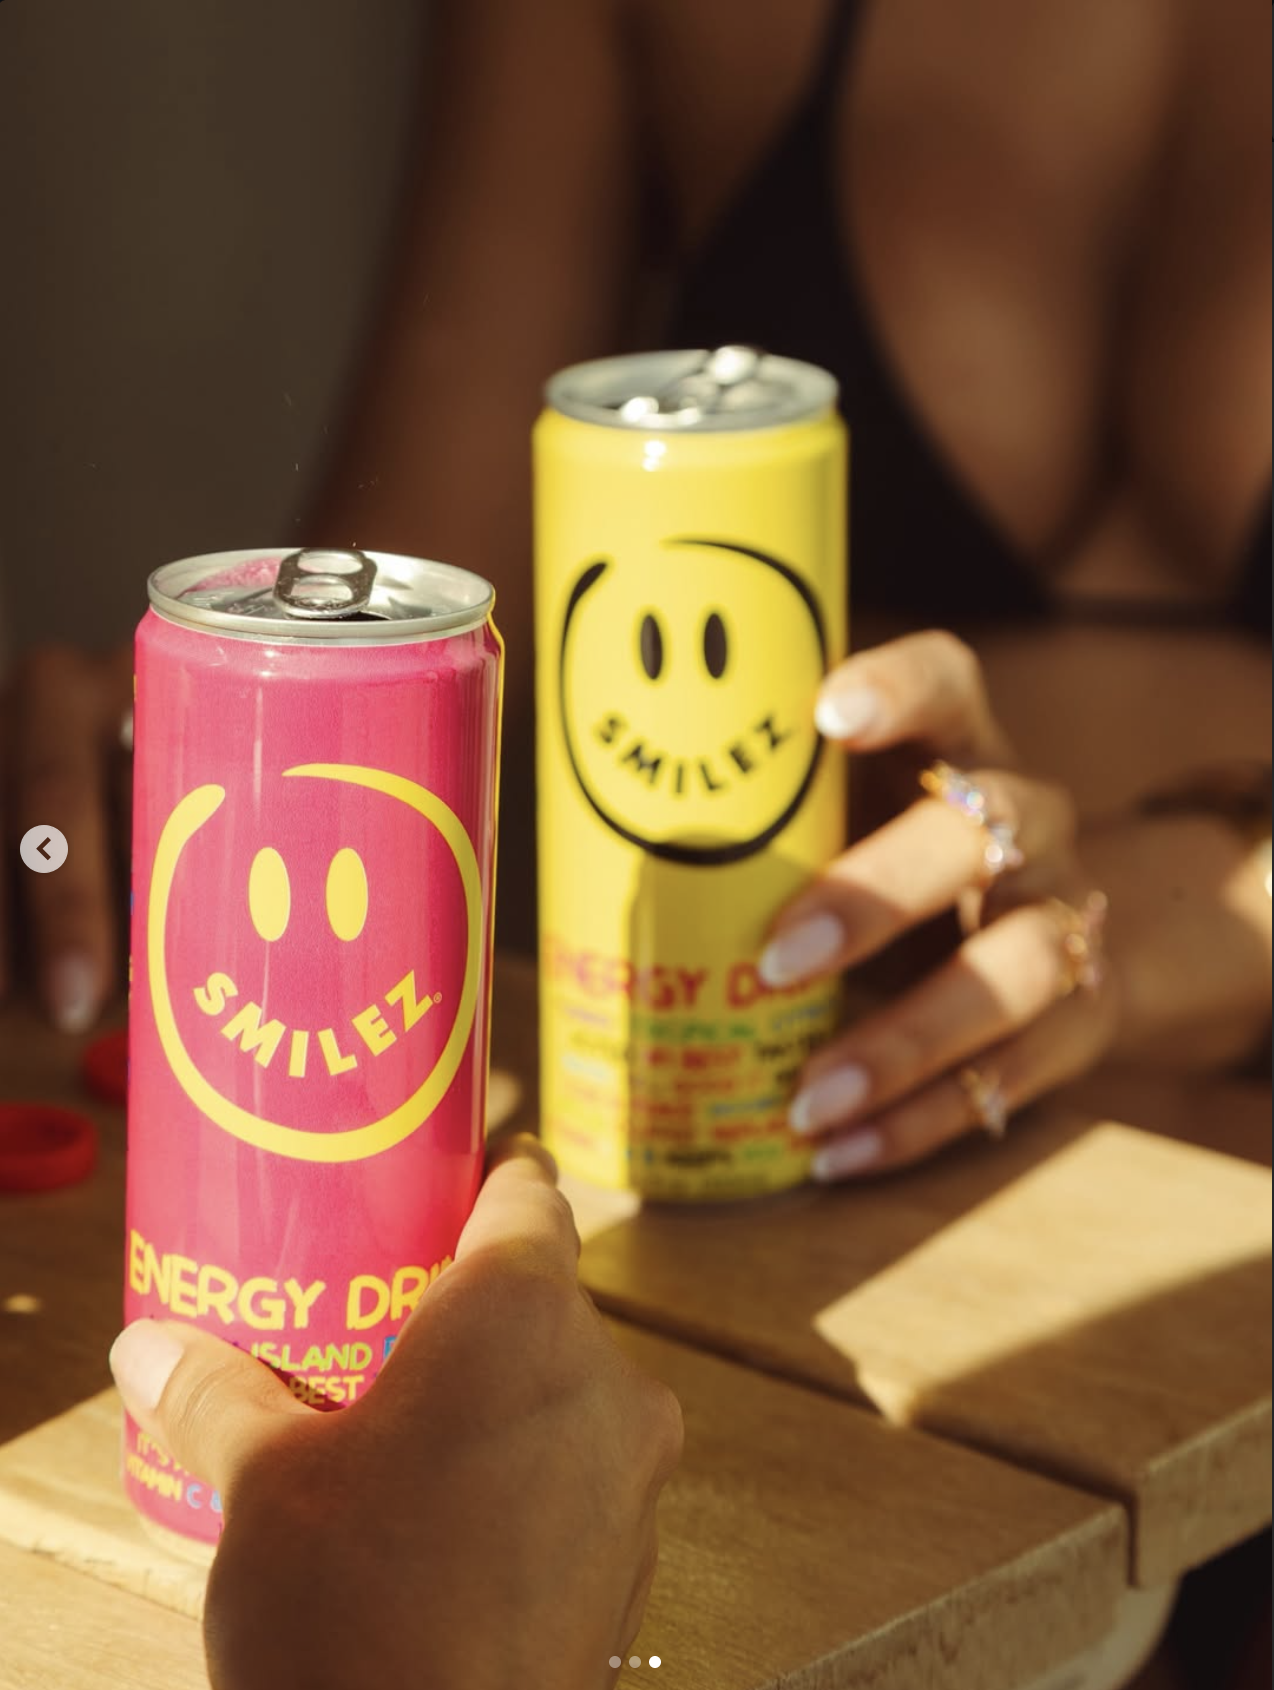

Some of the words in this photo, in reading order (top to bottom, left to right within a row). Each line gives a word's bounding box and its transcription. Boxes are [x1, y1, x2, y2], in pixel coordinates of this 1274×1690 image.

[597, 713, 790, 796] SMILEZ
[129, 1229, 326, 1330] ENERGY
[251, 1342, 373, 1371] ISLAND
[289, 1375, 365, 1404] BEST
[187, 1483, 202, 1509] C
